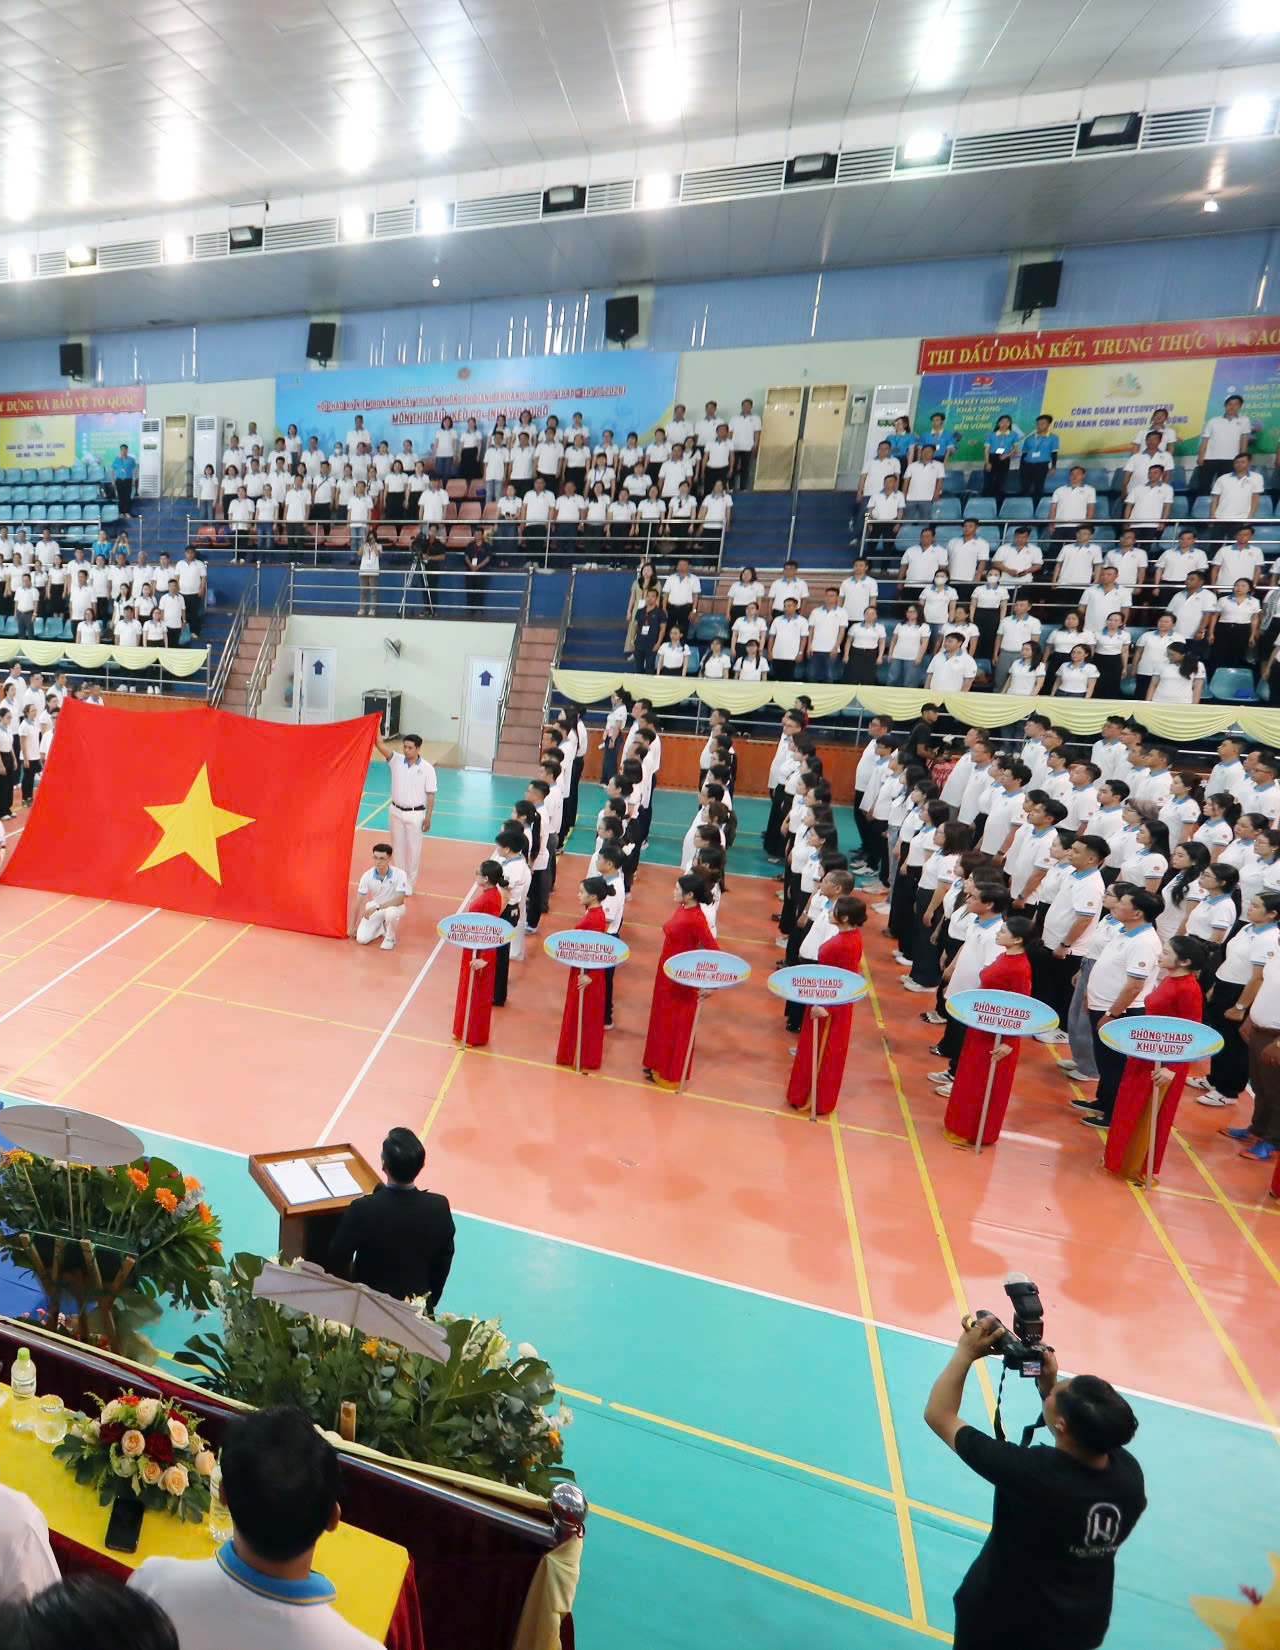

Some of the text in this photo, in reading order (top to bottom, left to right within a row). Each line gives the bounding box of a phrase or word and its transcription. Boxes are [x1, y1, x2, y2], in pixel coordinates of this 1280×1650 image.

[928, 350, 956, 367] THI
[998, 340, 1046, 362] ĐOÀN
[1048, 334, 1087, 359] KẾT,
[1092, 335, 1154, 357] TRUNG
[1158, 328, 1209, 354] THỰC
[6, 398, 34, 413] DỰNG
[792, 977, 843, 989] PHÒNG THADS
[798, 988, 814, 998] KHU
[972, 1001, 1031, 1020] PHÒNG THADS
[977, 1014, 996, 1025] KHU
[997, 1017, 1014, 1029] VỰC
[1130, 1028, 1194, 1044] PHÒNG THADS
[1136, 1042, 1185, 1056] KHU VỰC 7
